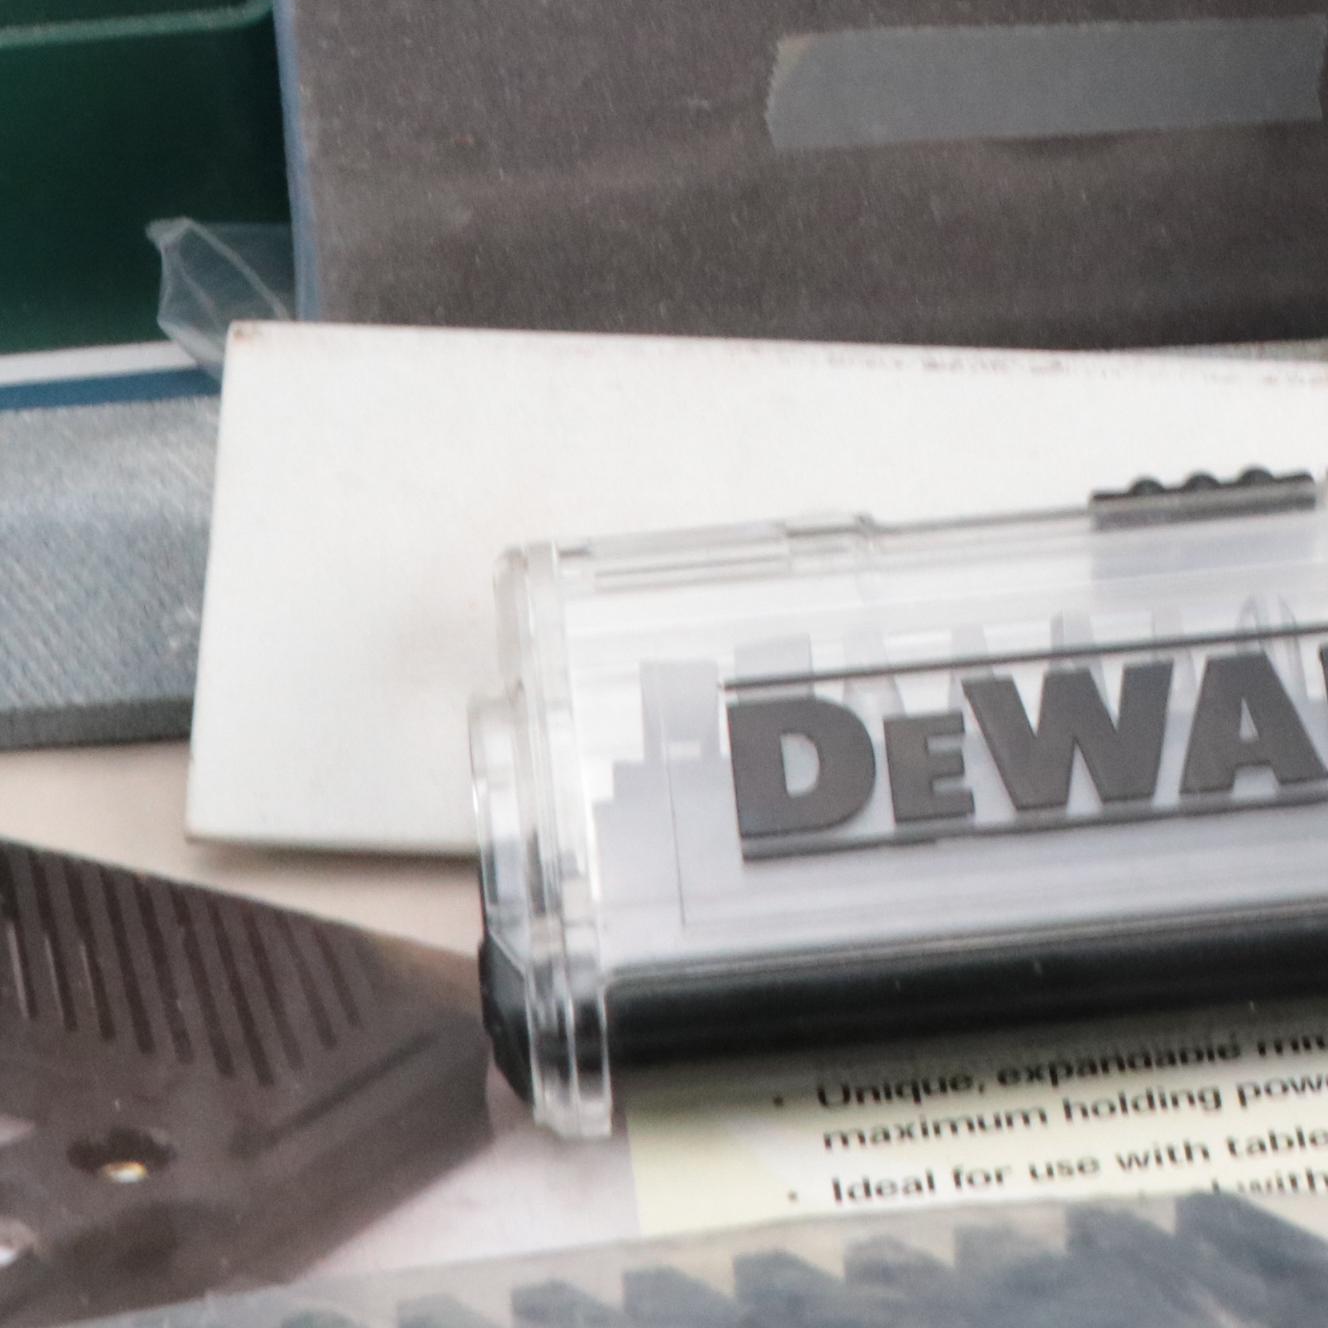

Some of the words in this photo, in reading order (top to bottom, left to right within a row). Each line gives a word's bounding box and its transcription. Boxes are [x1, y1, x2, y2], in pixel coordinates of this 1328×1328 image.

[816, 1073, 985, 1108] Unique,
[823, 1104, 1048, 1149] maximum
[1063, 1081, 1223, 1125] holding
[832, 1168, 935, 1202] Ideal
[952, 1161, 1014, 1191] for
[1029, 1155, 1100, 1183] use
[1115, 1137, 1211, 1172] with
